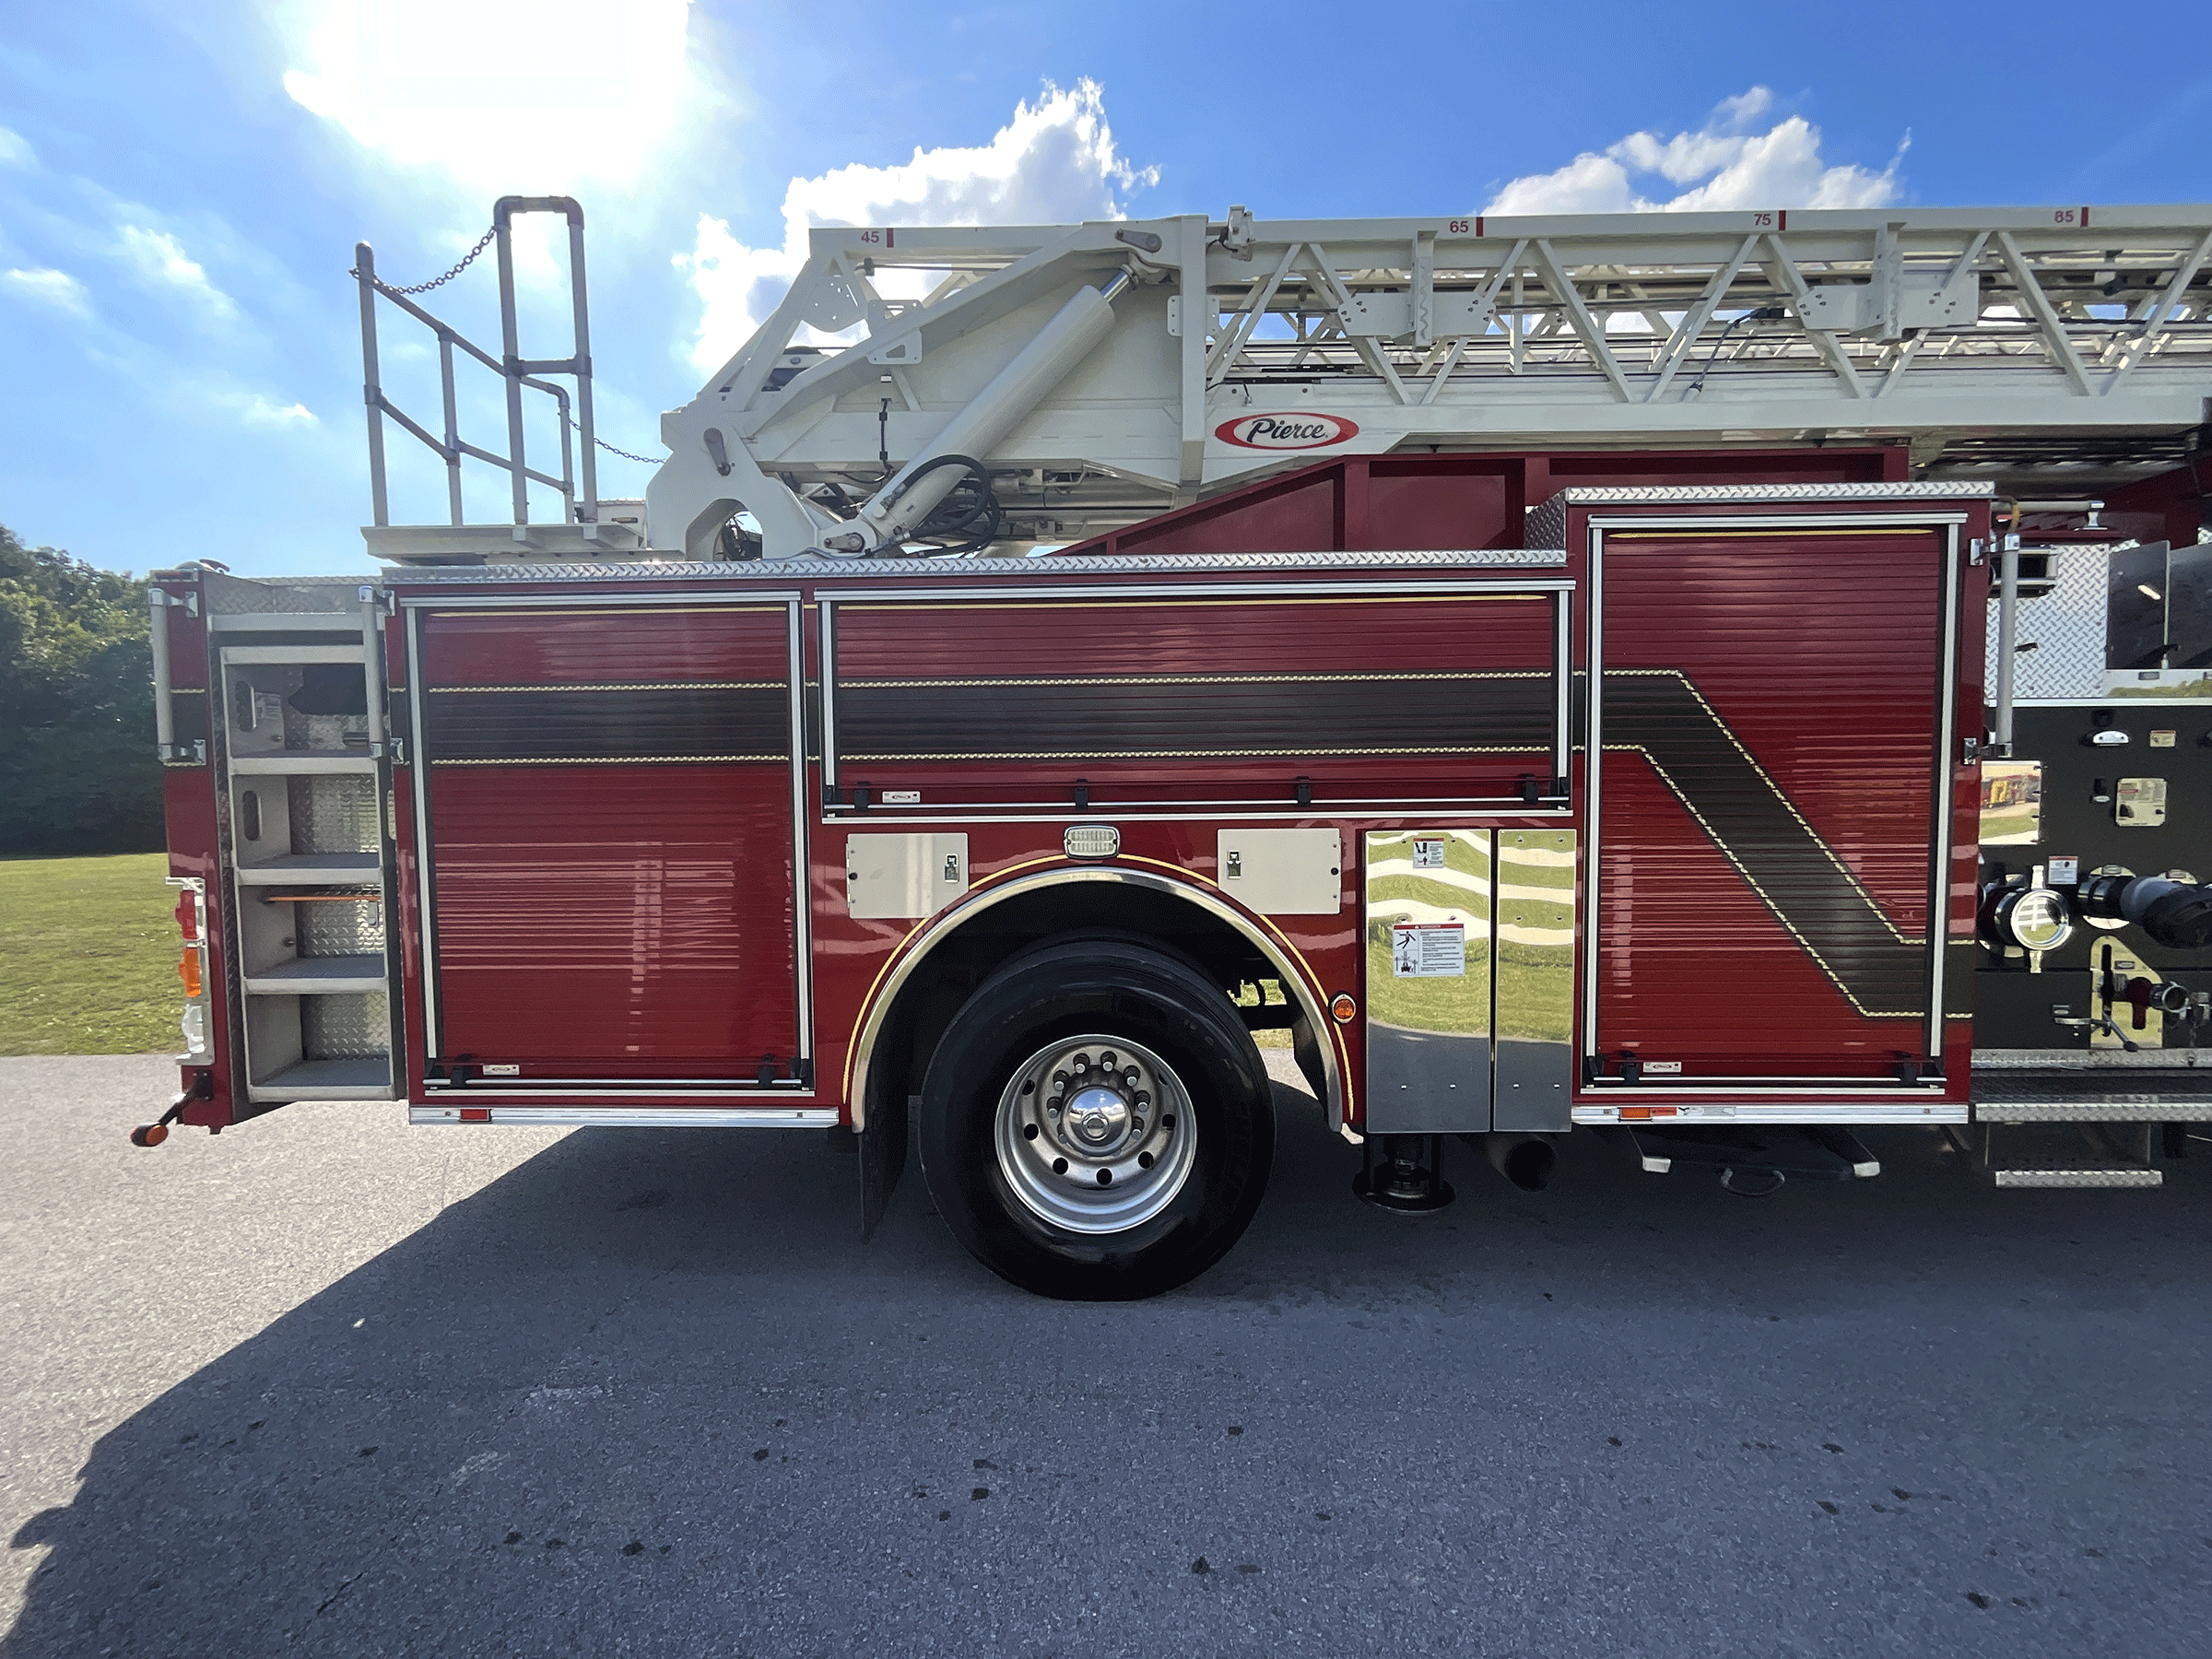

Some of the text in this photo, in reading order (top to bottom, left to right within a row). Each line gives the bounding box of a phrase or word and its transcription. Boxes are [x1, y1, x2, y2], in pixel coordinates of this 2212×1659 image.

[1754, 213, 1771, 226] 75
[2054, 210, 2074, 223] 85
[1449, 220, 1469, 233] 65
[861, 230, 880, 243] 45
[1246, 418, 1326, 443] Pierce
